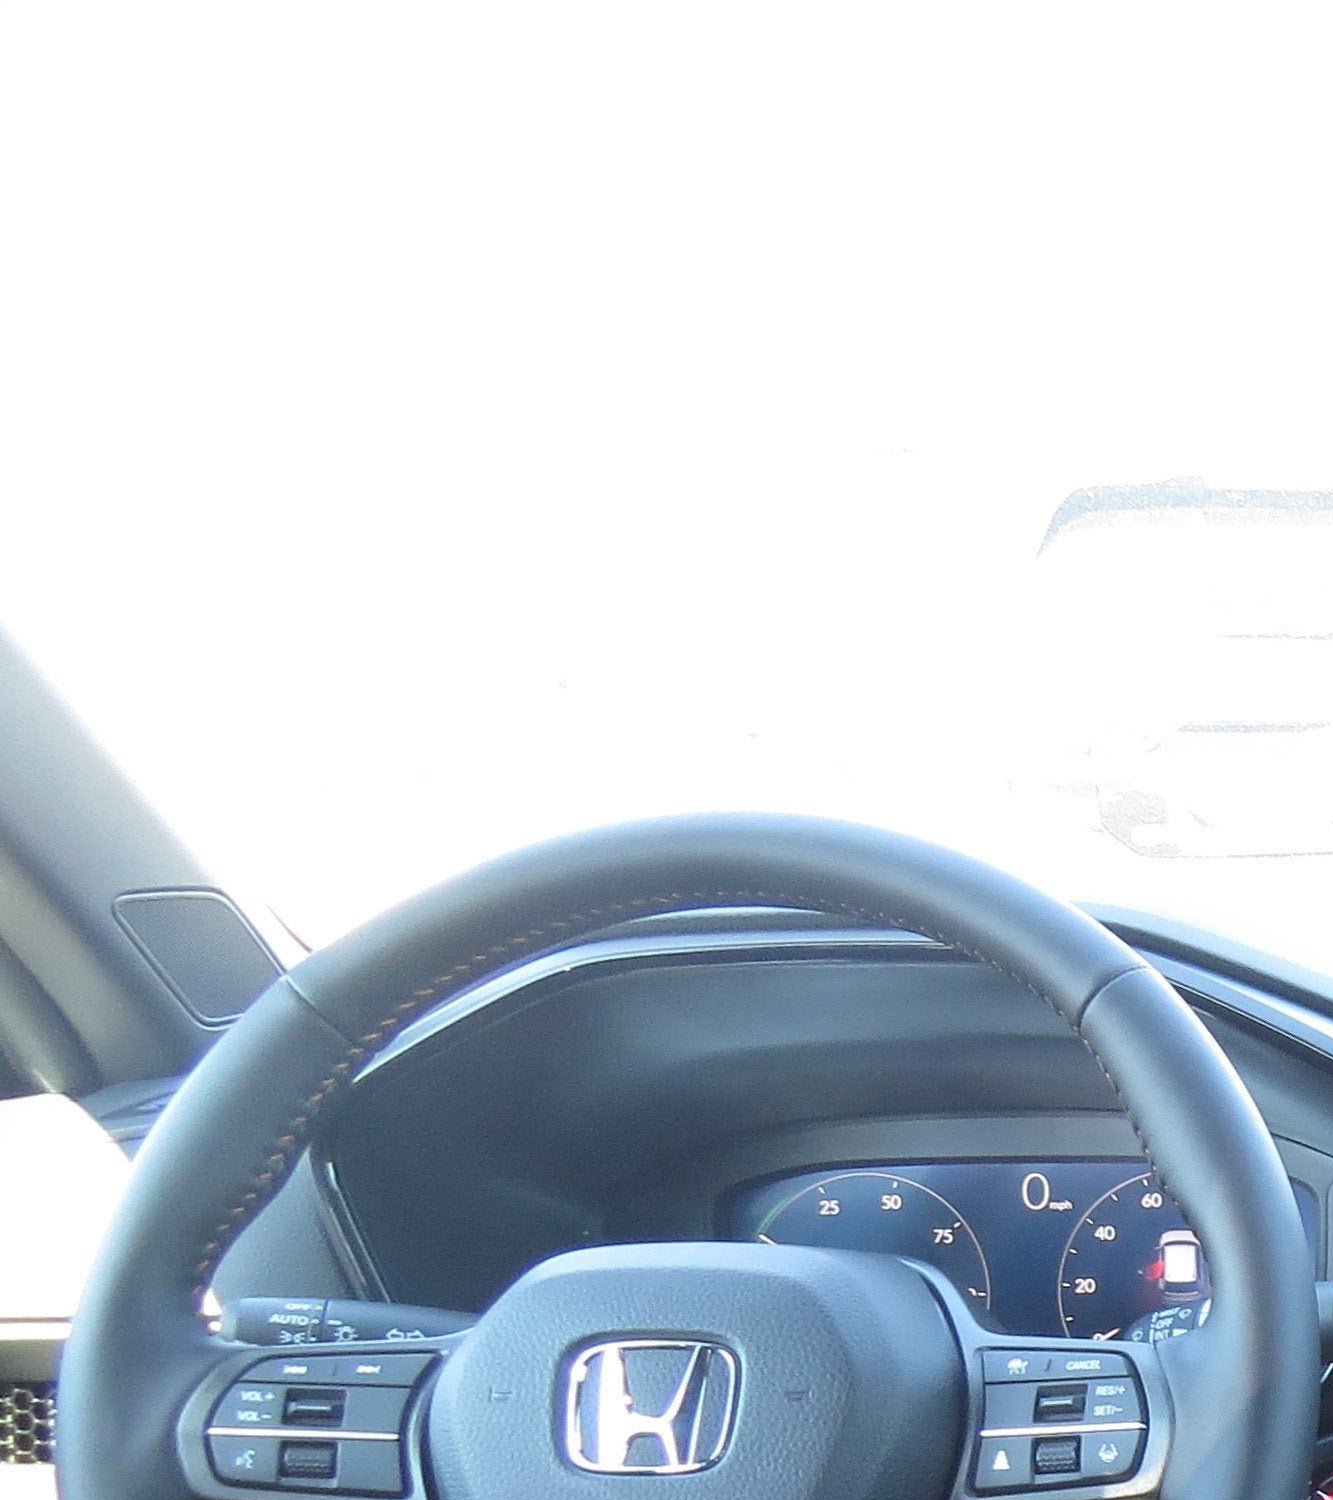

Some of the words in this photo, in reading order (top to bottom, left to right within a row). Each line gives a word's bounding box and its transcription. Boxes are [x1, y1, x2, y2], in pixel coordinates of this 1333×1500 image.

[1022, 1172, 1050, 1211] 0
[1050, 1200, 1074, 1212] mph
[819, 1200, 840, 1216] 25
[881, 1195, 903, 1210] 50
[1141, 1193, 1163, 1209] 60
[933, 1229, 954, 1244] 75
[1094, 1225, 1117, 1241] 40
[1075, 1278, 1097, 1294] 20
[269, 1313, 309, 1326] AUTO
